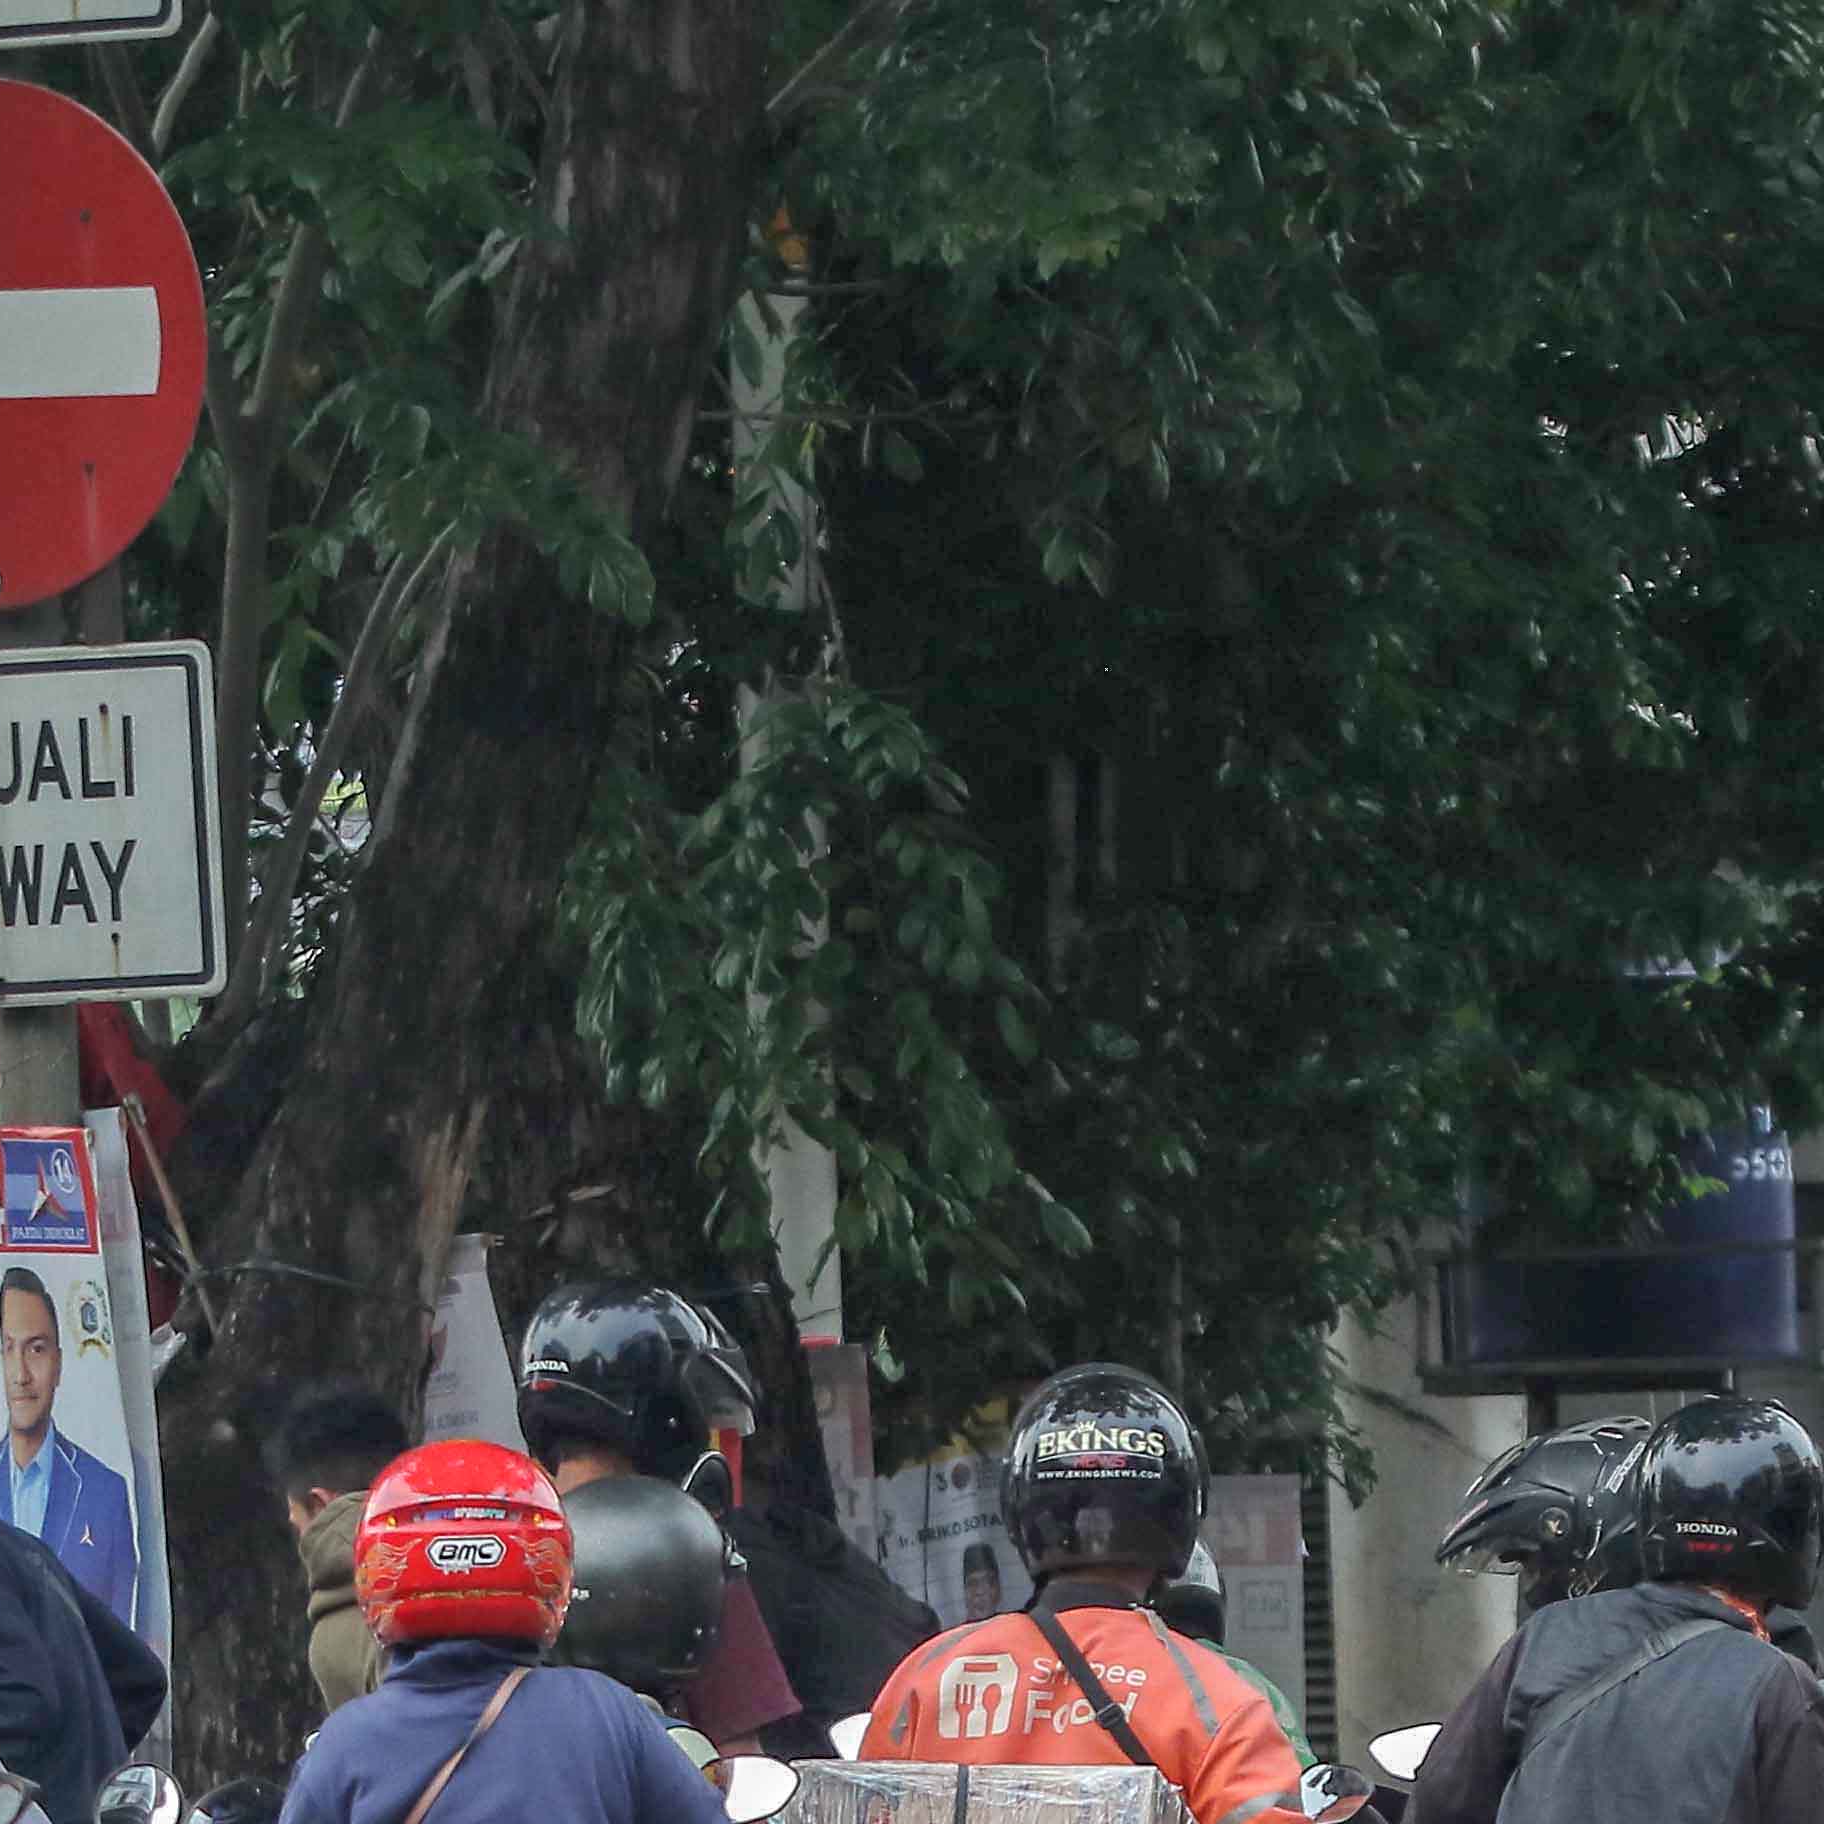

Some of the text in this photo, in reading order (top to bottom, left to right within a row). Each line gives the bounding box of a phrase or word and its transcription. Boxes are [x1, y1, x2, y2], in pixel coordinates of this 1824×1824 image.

[55, 1157, 74, 1184] 14
[1676, 1522, 1738, 1537] HONDA
[438, 1541, 495, 1566] BMC
[1029, 1657, 1147, 1687] Shee
